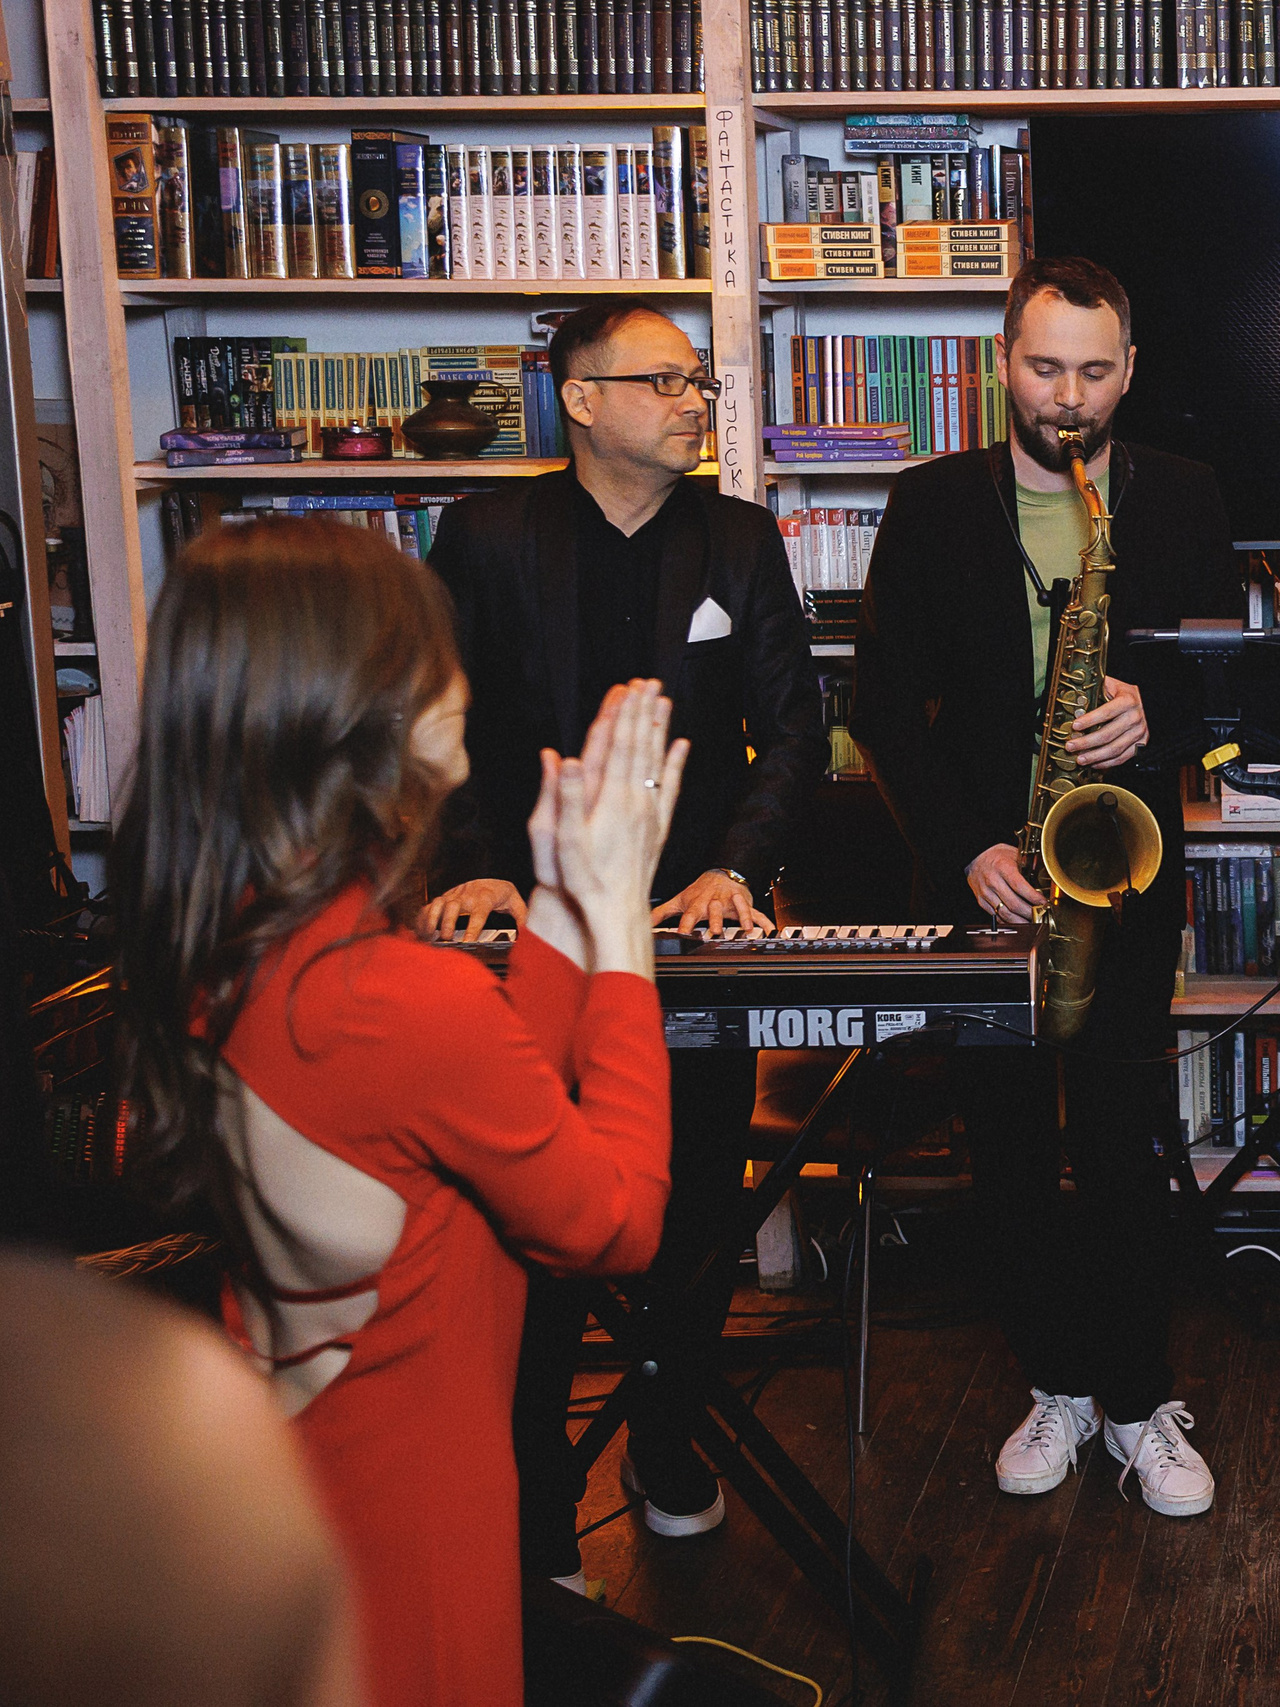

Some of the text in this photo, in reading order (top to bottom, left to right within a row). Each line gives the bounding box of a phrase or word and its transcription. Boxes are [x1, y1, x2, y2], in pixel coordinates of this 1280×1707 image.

[857, 19, 865, 48] КУПРИН
[908, 13, 917, 55] ЛЕРМОНТОВ
[943, 11, 952, 58] МАЯКОВСКИЙ
[1021, 16, 1029, 48] ПУШКИН
[1040, 17, 1048, 49] ПУШКИН
[1057, 16, 1065, 48] ПУШКИН
[1077, 16, 1085, 48] ПУШКИН
[1098, 16, 1106, 48] ПУШКИН
[1116, 15, 1124, 48] РЫБАКОВ
[1153, 14, 1161, 48] ТОЛСТОЙ
[881, 168, 892, 189] КИНГ
[911, 165, 922, 185] КИНГ
[716, 110, 736, 288] ФАНТАСТИКА
[808, 185, 818, 211] КИНГ
[824, 186, 834, 211] КИНГ
[847, 185, 857, 209] КИНГ
[822, 231, 871, 240] СТИВЕН КИНГ
[951, 229, 998, 238] СТИВЕН КИНГ
[853, 250, 871, 258] КИНГ
[981, 261, 999, 269] КИНГ
[827, 266, 854, 274] СТИВЕН
[439, 371, 492, 381] МАКС ФРАЙ
[724, 374, 742, 500] РУССК
[859, 531, 872, 556] Лавр
[748, 1008, 864, 1047] KORG
[877, 1013, 902, 1022] KORG
